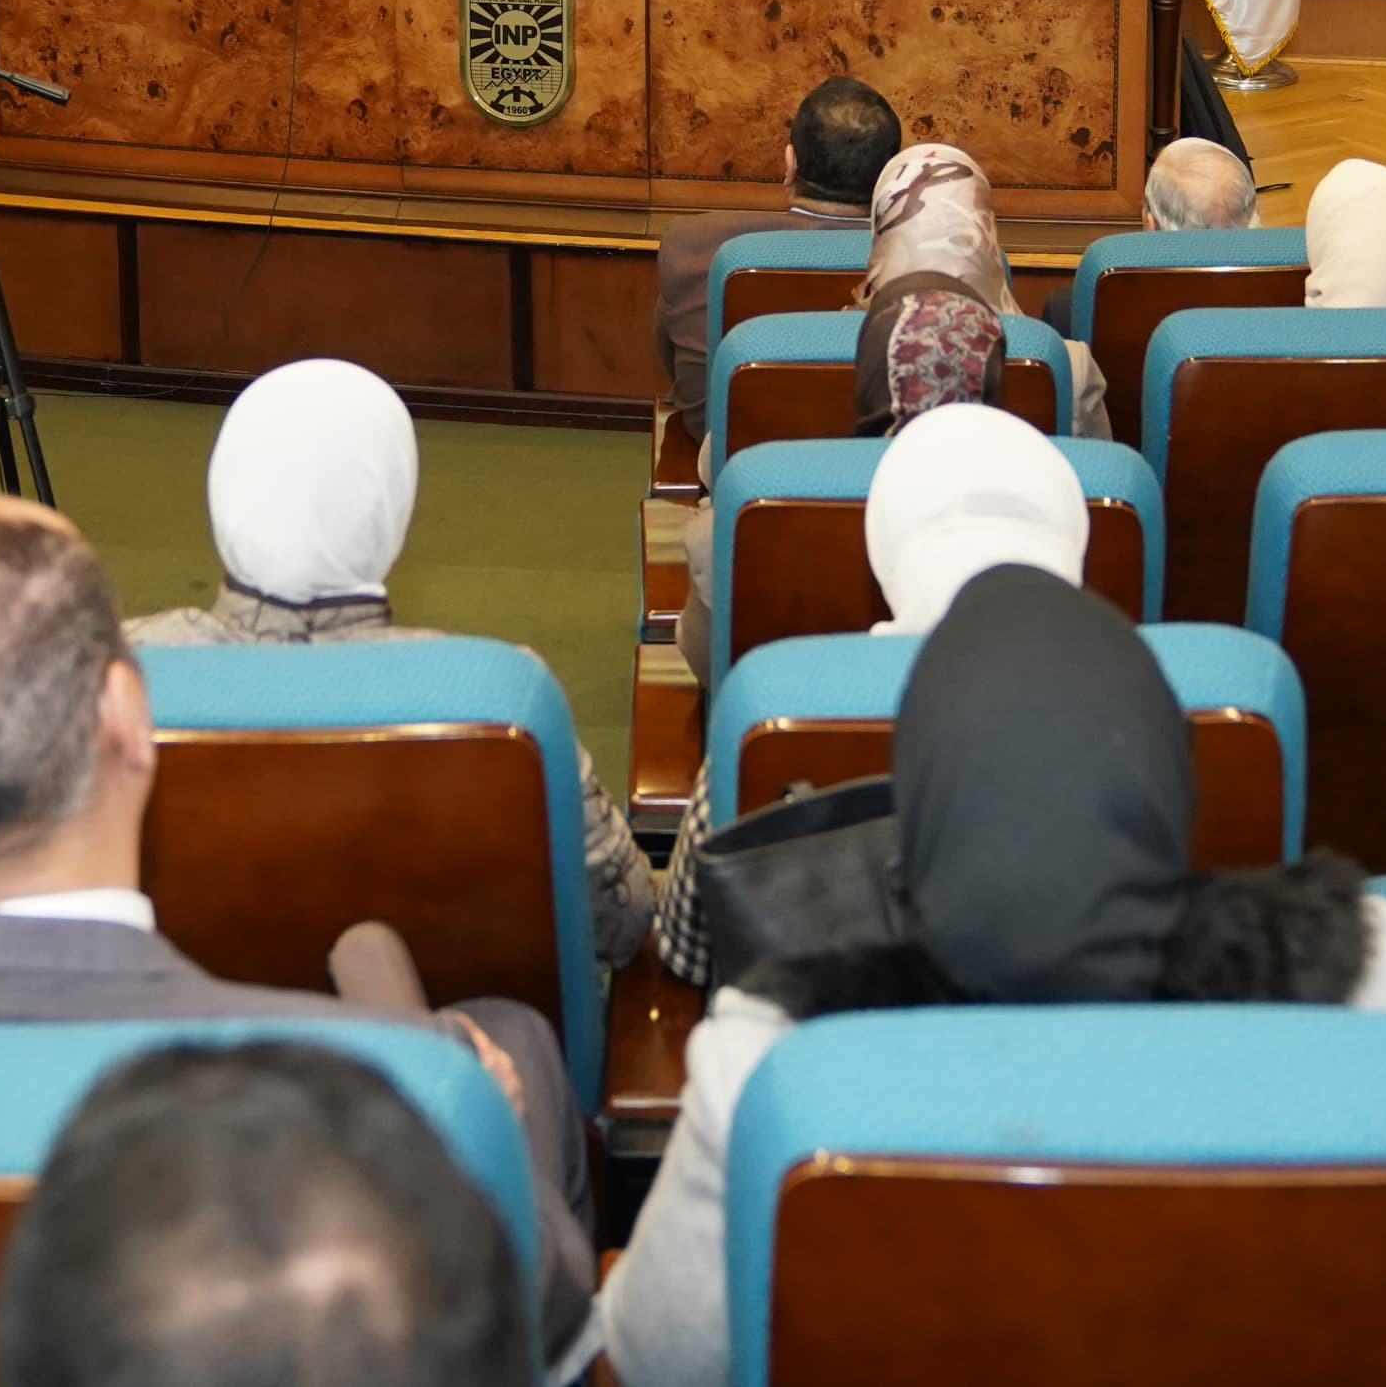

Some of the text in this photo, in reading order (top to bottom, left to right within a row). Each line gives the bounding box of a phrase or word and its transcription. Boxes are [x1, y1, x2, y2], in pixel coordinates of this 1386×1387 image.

[494, 24, 538, 46] INP
[491, 67, 542, 81] EGYPT
[506, 104, 528, 114] 1960
